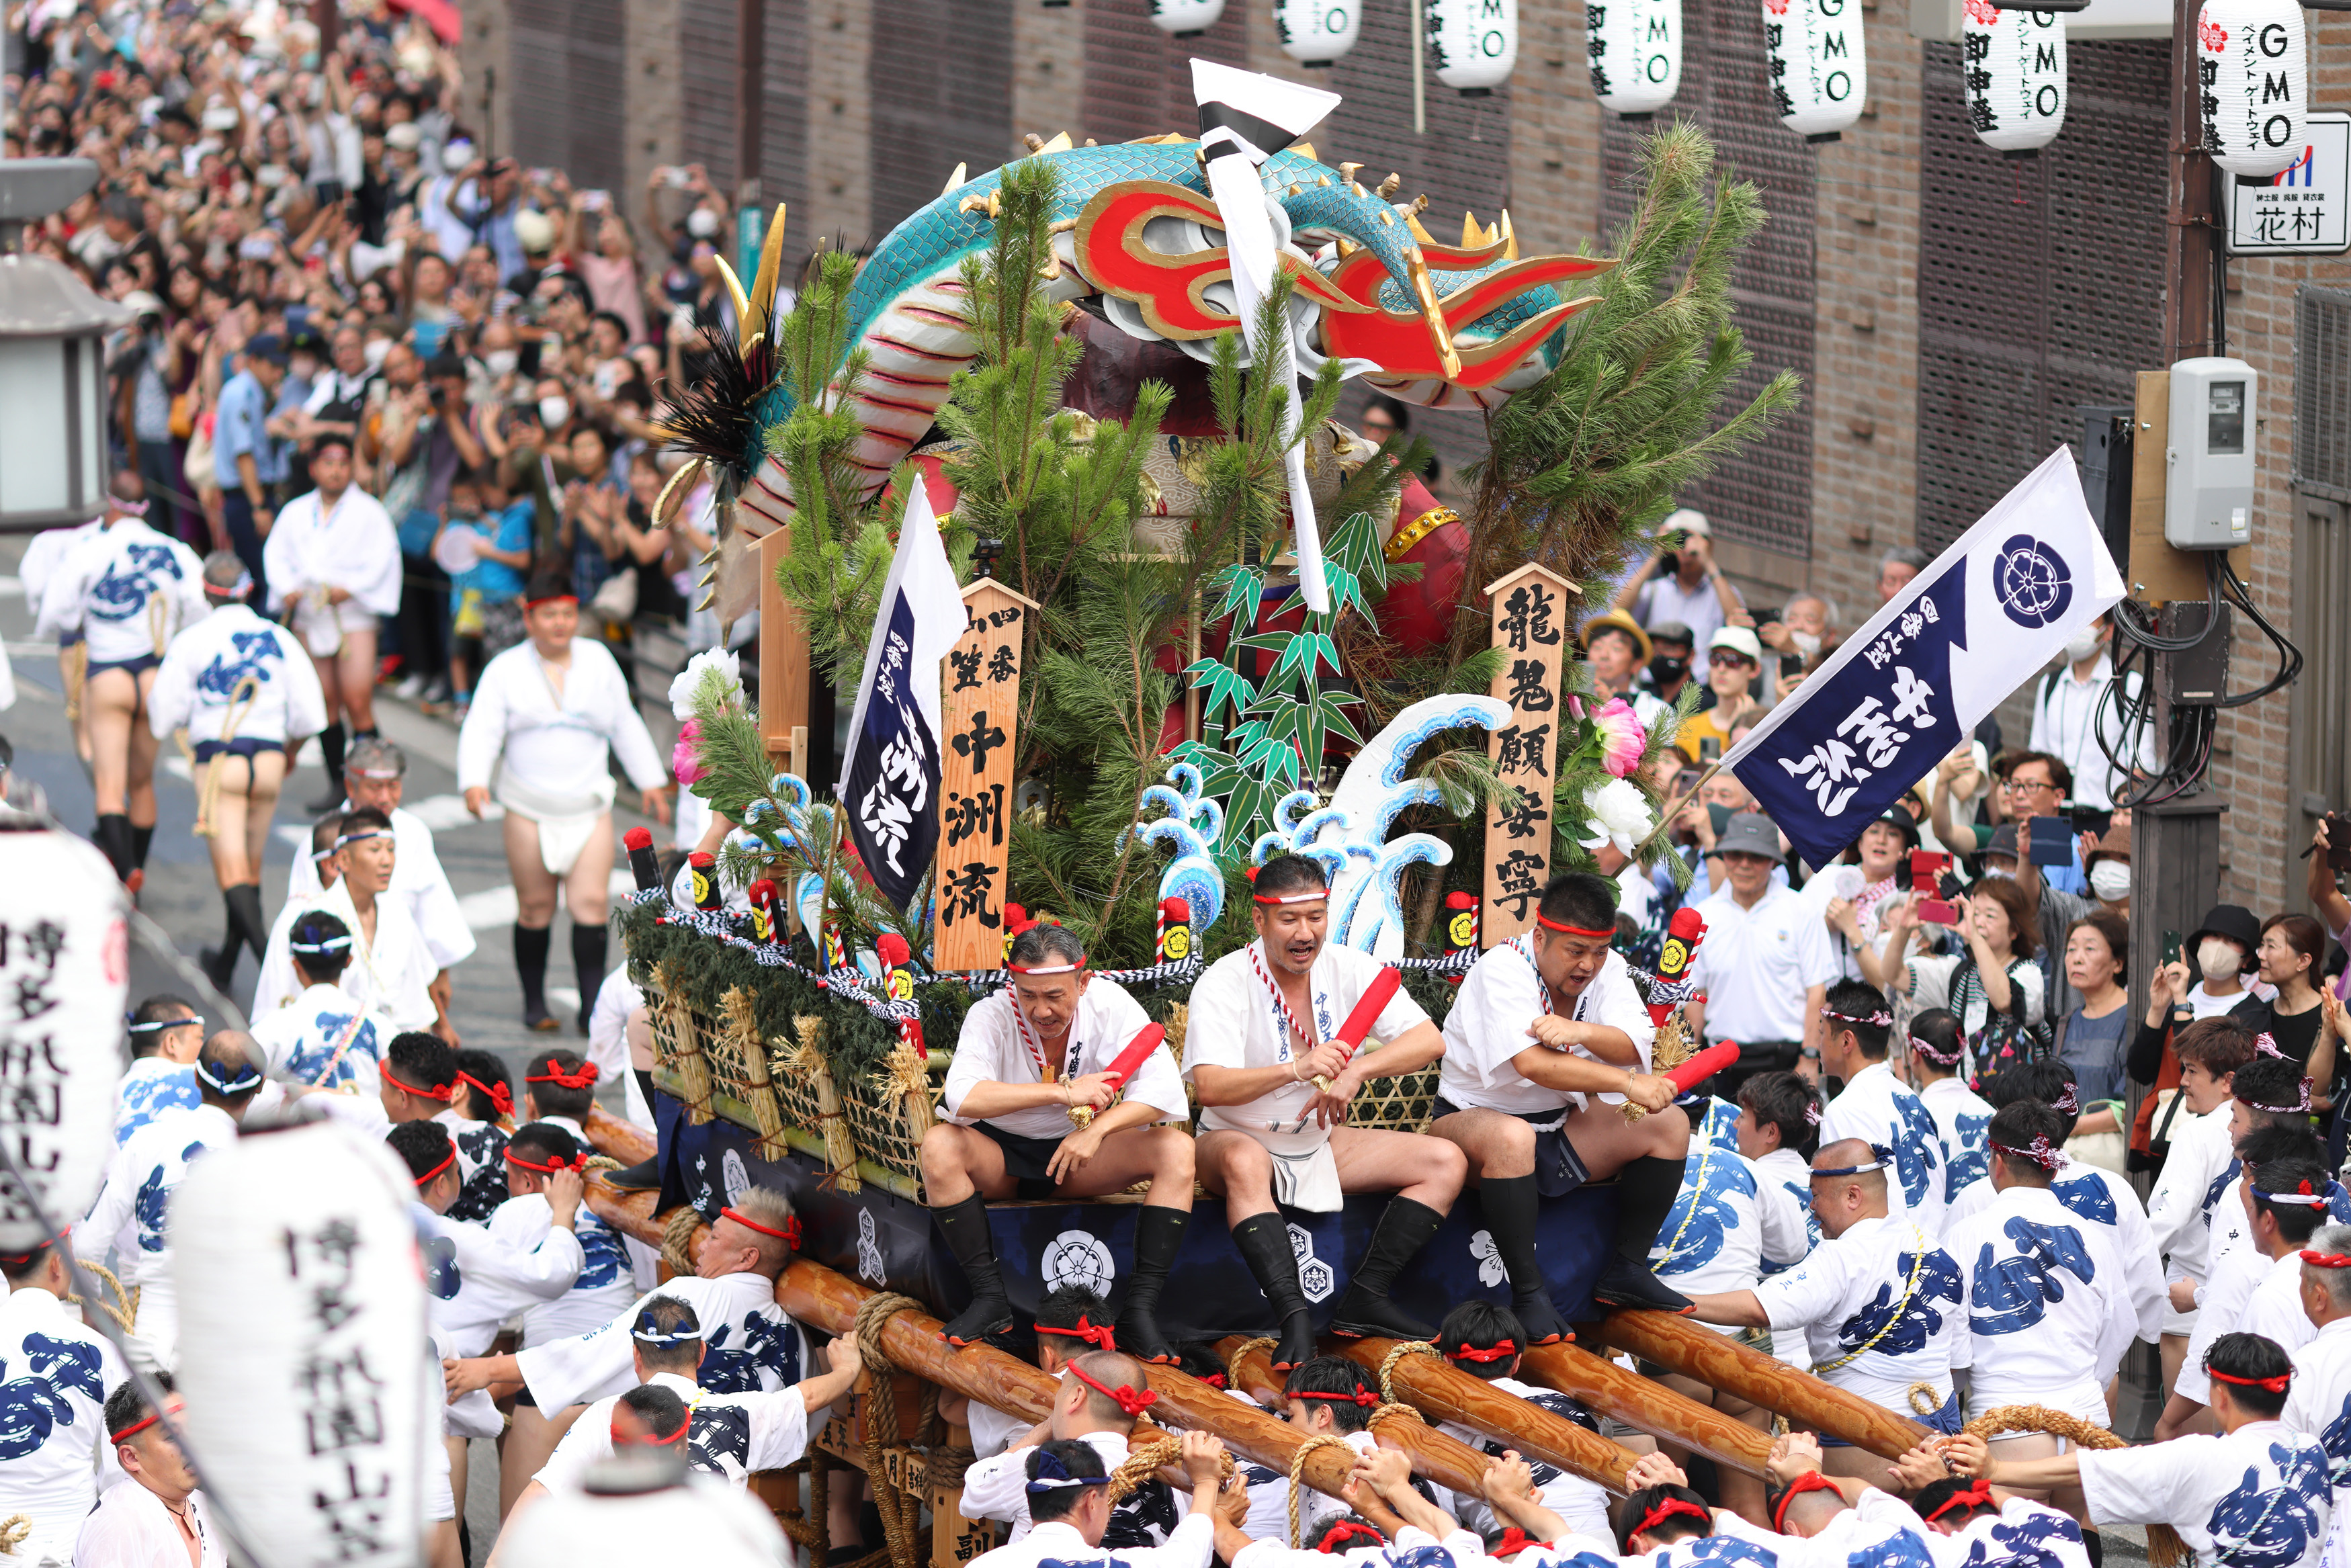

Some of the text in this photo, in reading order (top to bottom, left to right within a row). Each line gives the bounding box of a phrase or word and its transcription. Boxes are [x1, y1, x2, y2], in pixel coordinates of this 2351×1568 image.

[1482, 0, 1504, 57] MO
[1648, 0, 1668, 83] MO
[2241, 23, 2260, 150] ペイメントゲートウェイ
[2259, 23, 2292, 148] GMO
[2256, 206, 2325, 241] 花村
[987, 607, 1021, 683] 四番
[941, 710, 1007, 930] 中洲流
